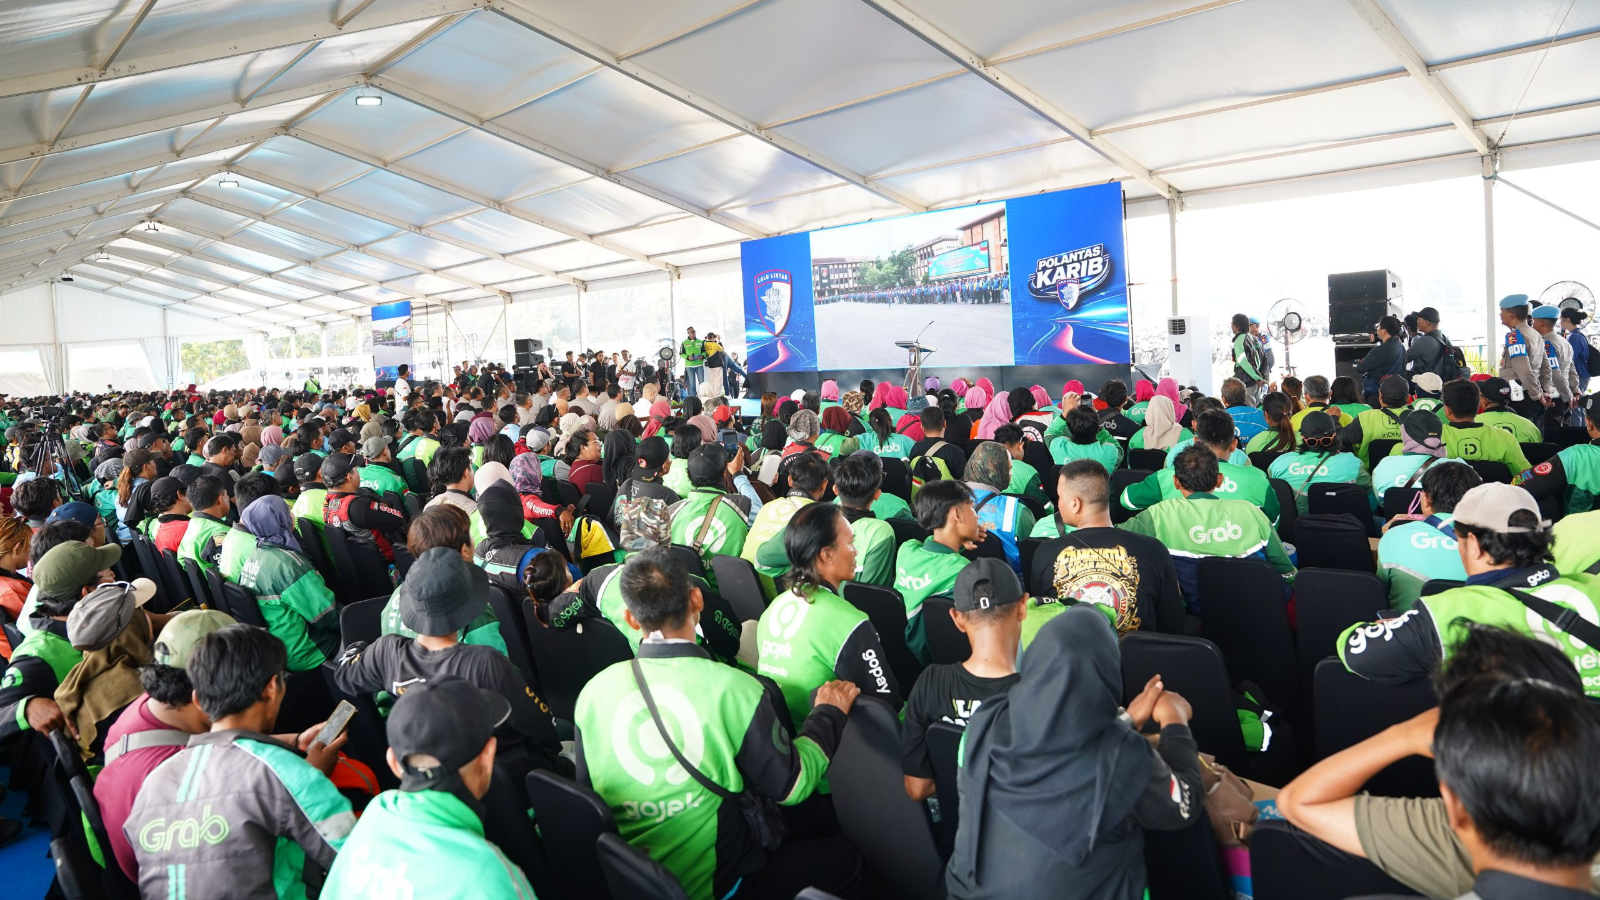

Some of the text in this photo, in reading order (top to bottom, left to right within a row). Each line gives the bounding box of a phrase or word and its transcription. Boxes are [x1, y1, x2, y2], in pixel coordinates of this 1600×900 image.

[1038, 246, 1101, 270] POLANTAS
[770, 272, 788, 281] LINTAS
[1036, 256, 1104, 289] KARIB
[873, 442, 901, 455] Grab
[759, 521, 783, 533] goje
[1188, 520, 1243, 545] Grab
[1410, 531, 1459, 550] Gra
[760, 640, 794, 659] gojek
[862, 649, 891, 694] gopay
[622, 792, 706, 823] gojek
[138, 804, 230, 853] Grab
